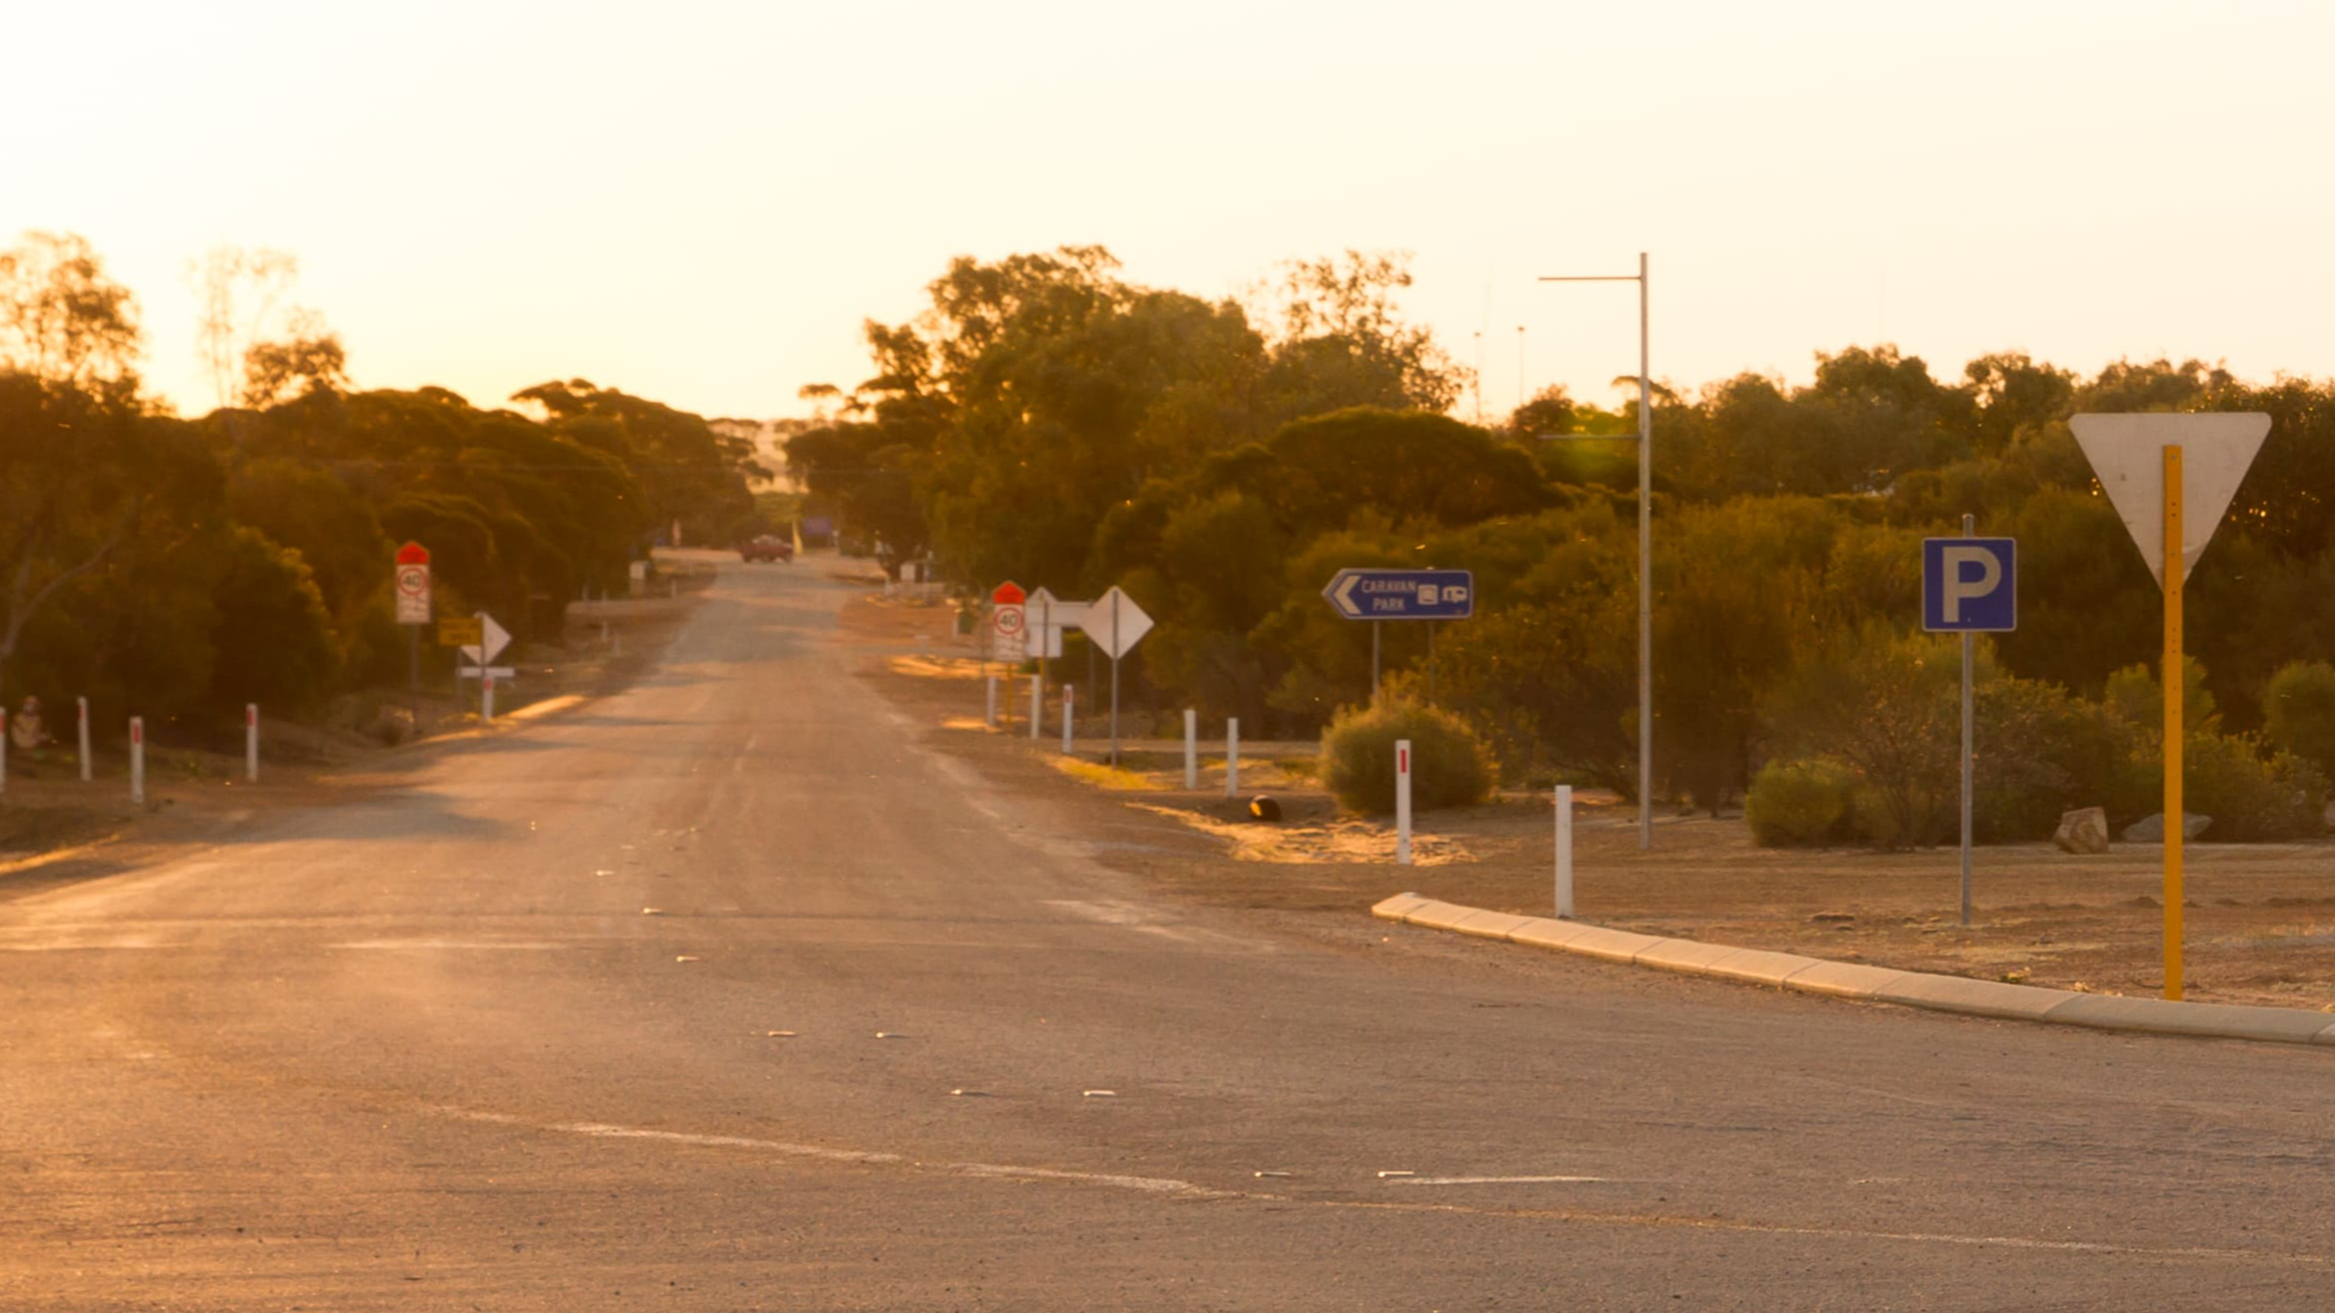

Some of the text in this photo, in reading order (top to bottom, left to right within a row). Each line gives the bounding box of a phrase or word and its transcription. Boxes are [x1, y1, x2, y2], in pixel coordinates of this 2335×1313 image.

[1361, 580, 1416, 593] CARAVAN
[1942, 546, 2002, 623] P
[1372, 597, 1405, 611] PARK
[1000, 614, 1018, 627] 40
